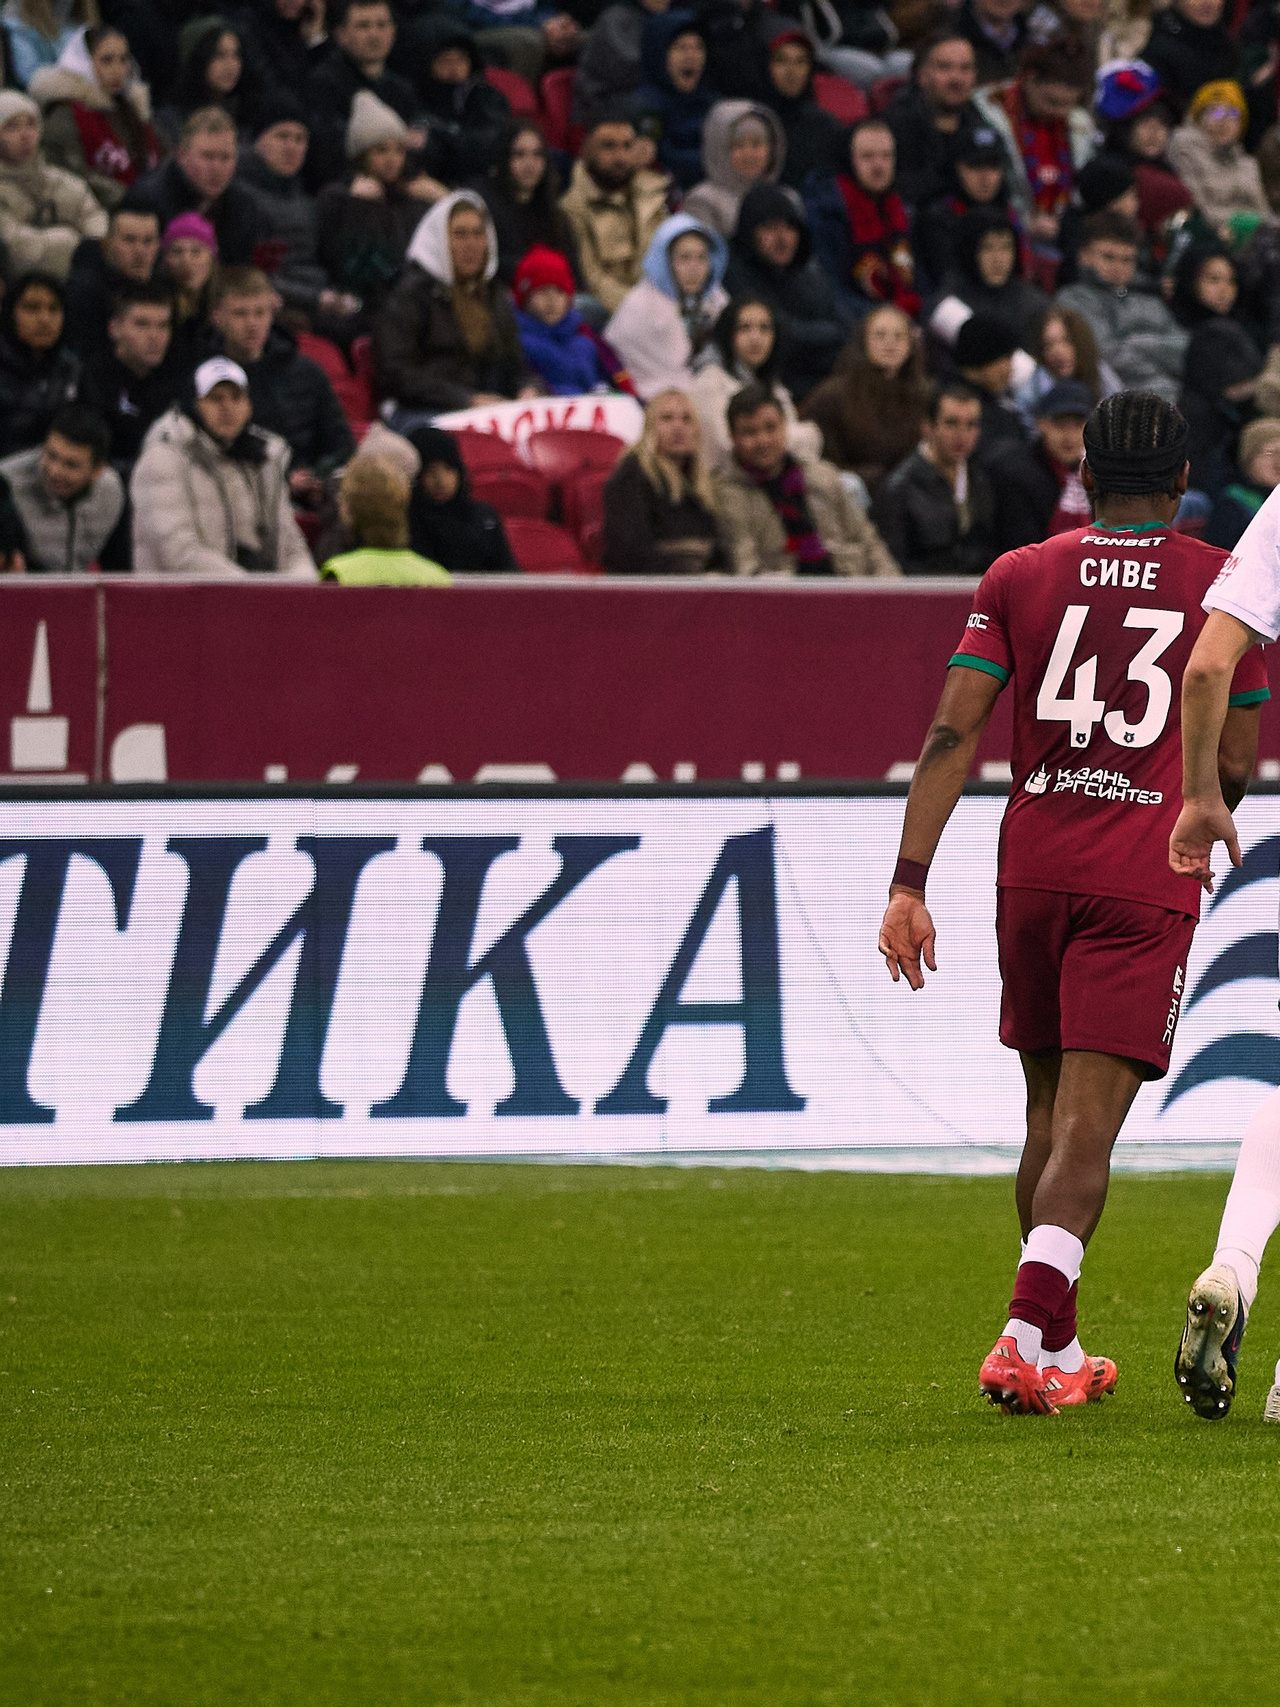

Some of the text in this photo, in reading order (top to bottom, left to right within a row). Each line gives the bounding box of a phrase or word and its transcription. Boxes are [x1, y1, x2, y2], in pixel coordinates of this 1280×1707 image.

[1080, 535, 1166, 547] FONBET
[1079, 557, 1161, 591] СИВЕ
[1036, 604, 1185, 749] 43
[1057, 767, 1131, 788] КАЗАНЬ
